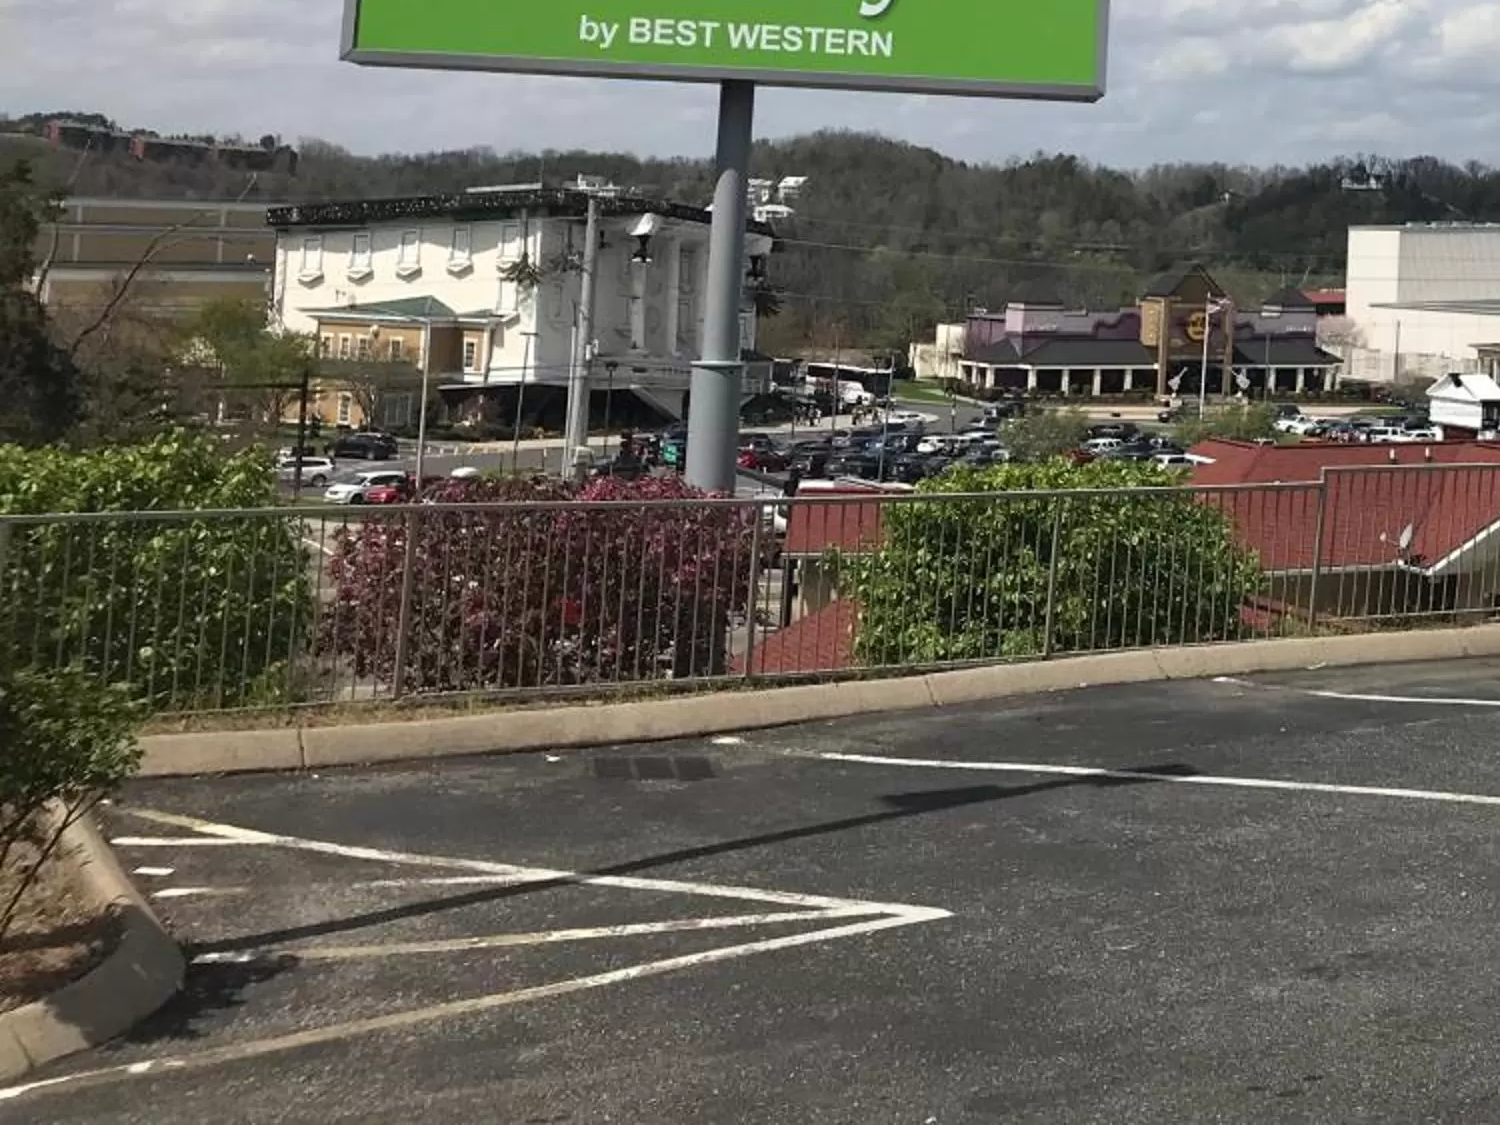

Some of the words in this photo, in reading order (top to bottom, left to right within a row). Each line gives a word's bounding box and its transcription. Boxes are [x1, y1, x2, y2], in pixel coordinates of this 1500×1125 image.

[578, 13, 620, 48] by
[628, 17, 721, 48] BEST
[726, 22, 894, 58] WESTERN
